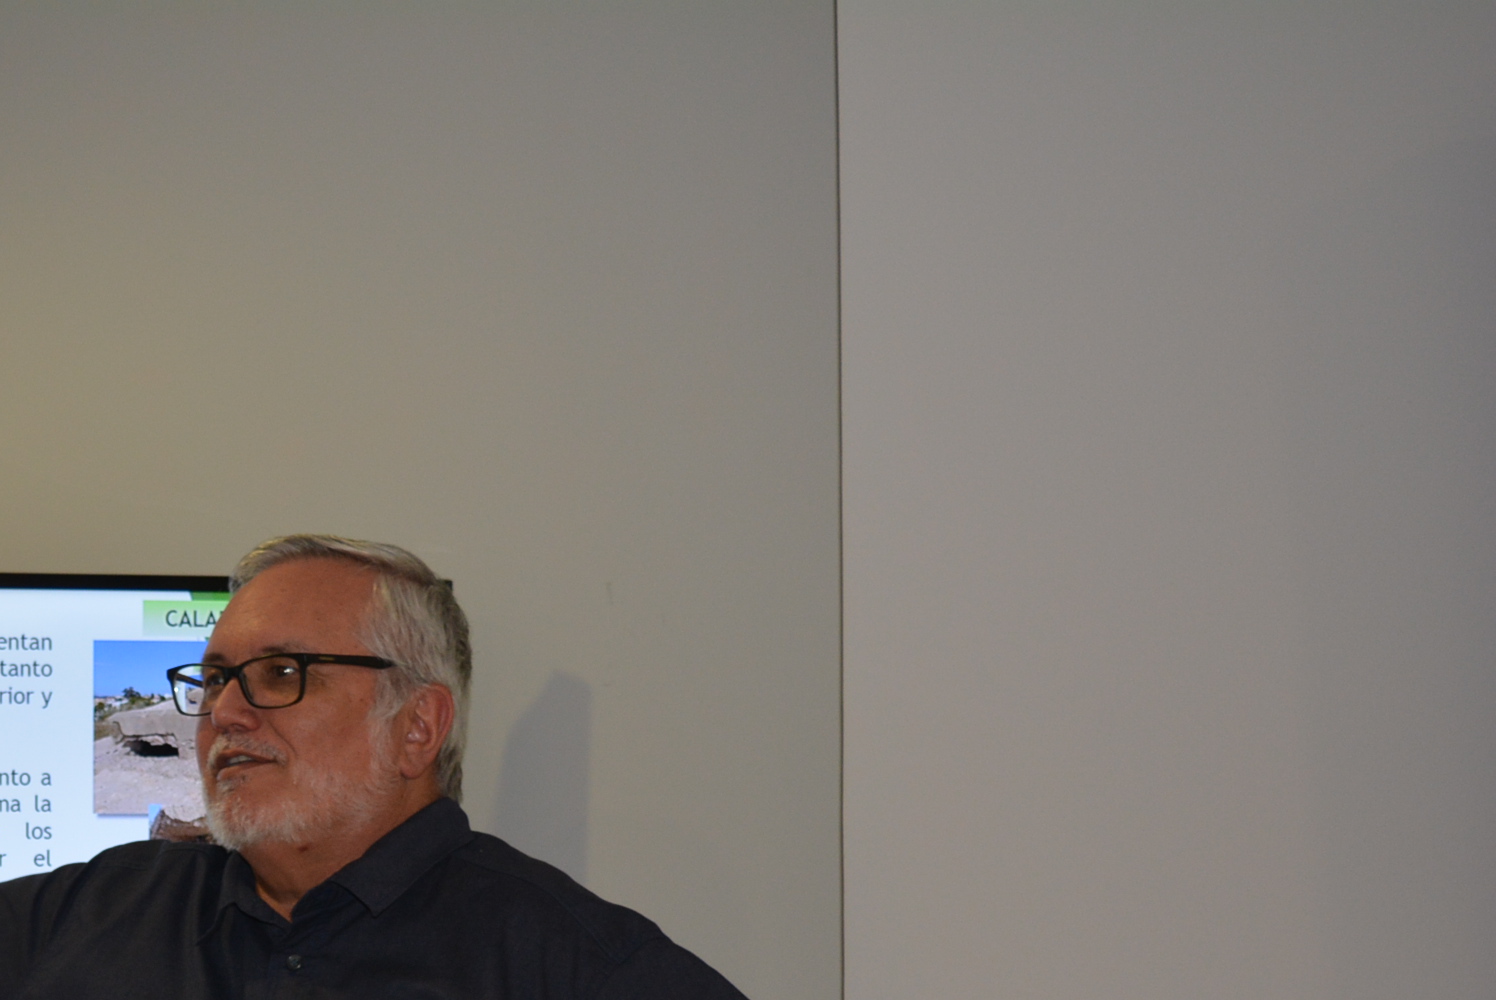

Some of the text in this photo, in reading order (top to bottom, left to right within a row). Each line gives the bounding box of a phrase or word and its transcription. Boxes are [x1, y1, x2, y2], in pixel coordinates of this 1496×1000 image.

[165, 609, 224, 628] CALA
[0, 660, 53, 678] tanto
[40, 691, 53, 710] y
[40, 772, 52, 787] a
[34, 794, 52, 813] la
[25, 821, 53, 841] los
[33, 849, 52, 868] el
